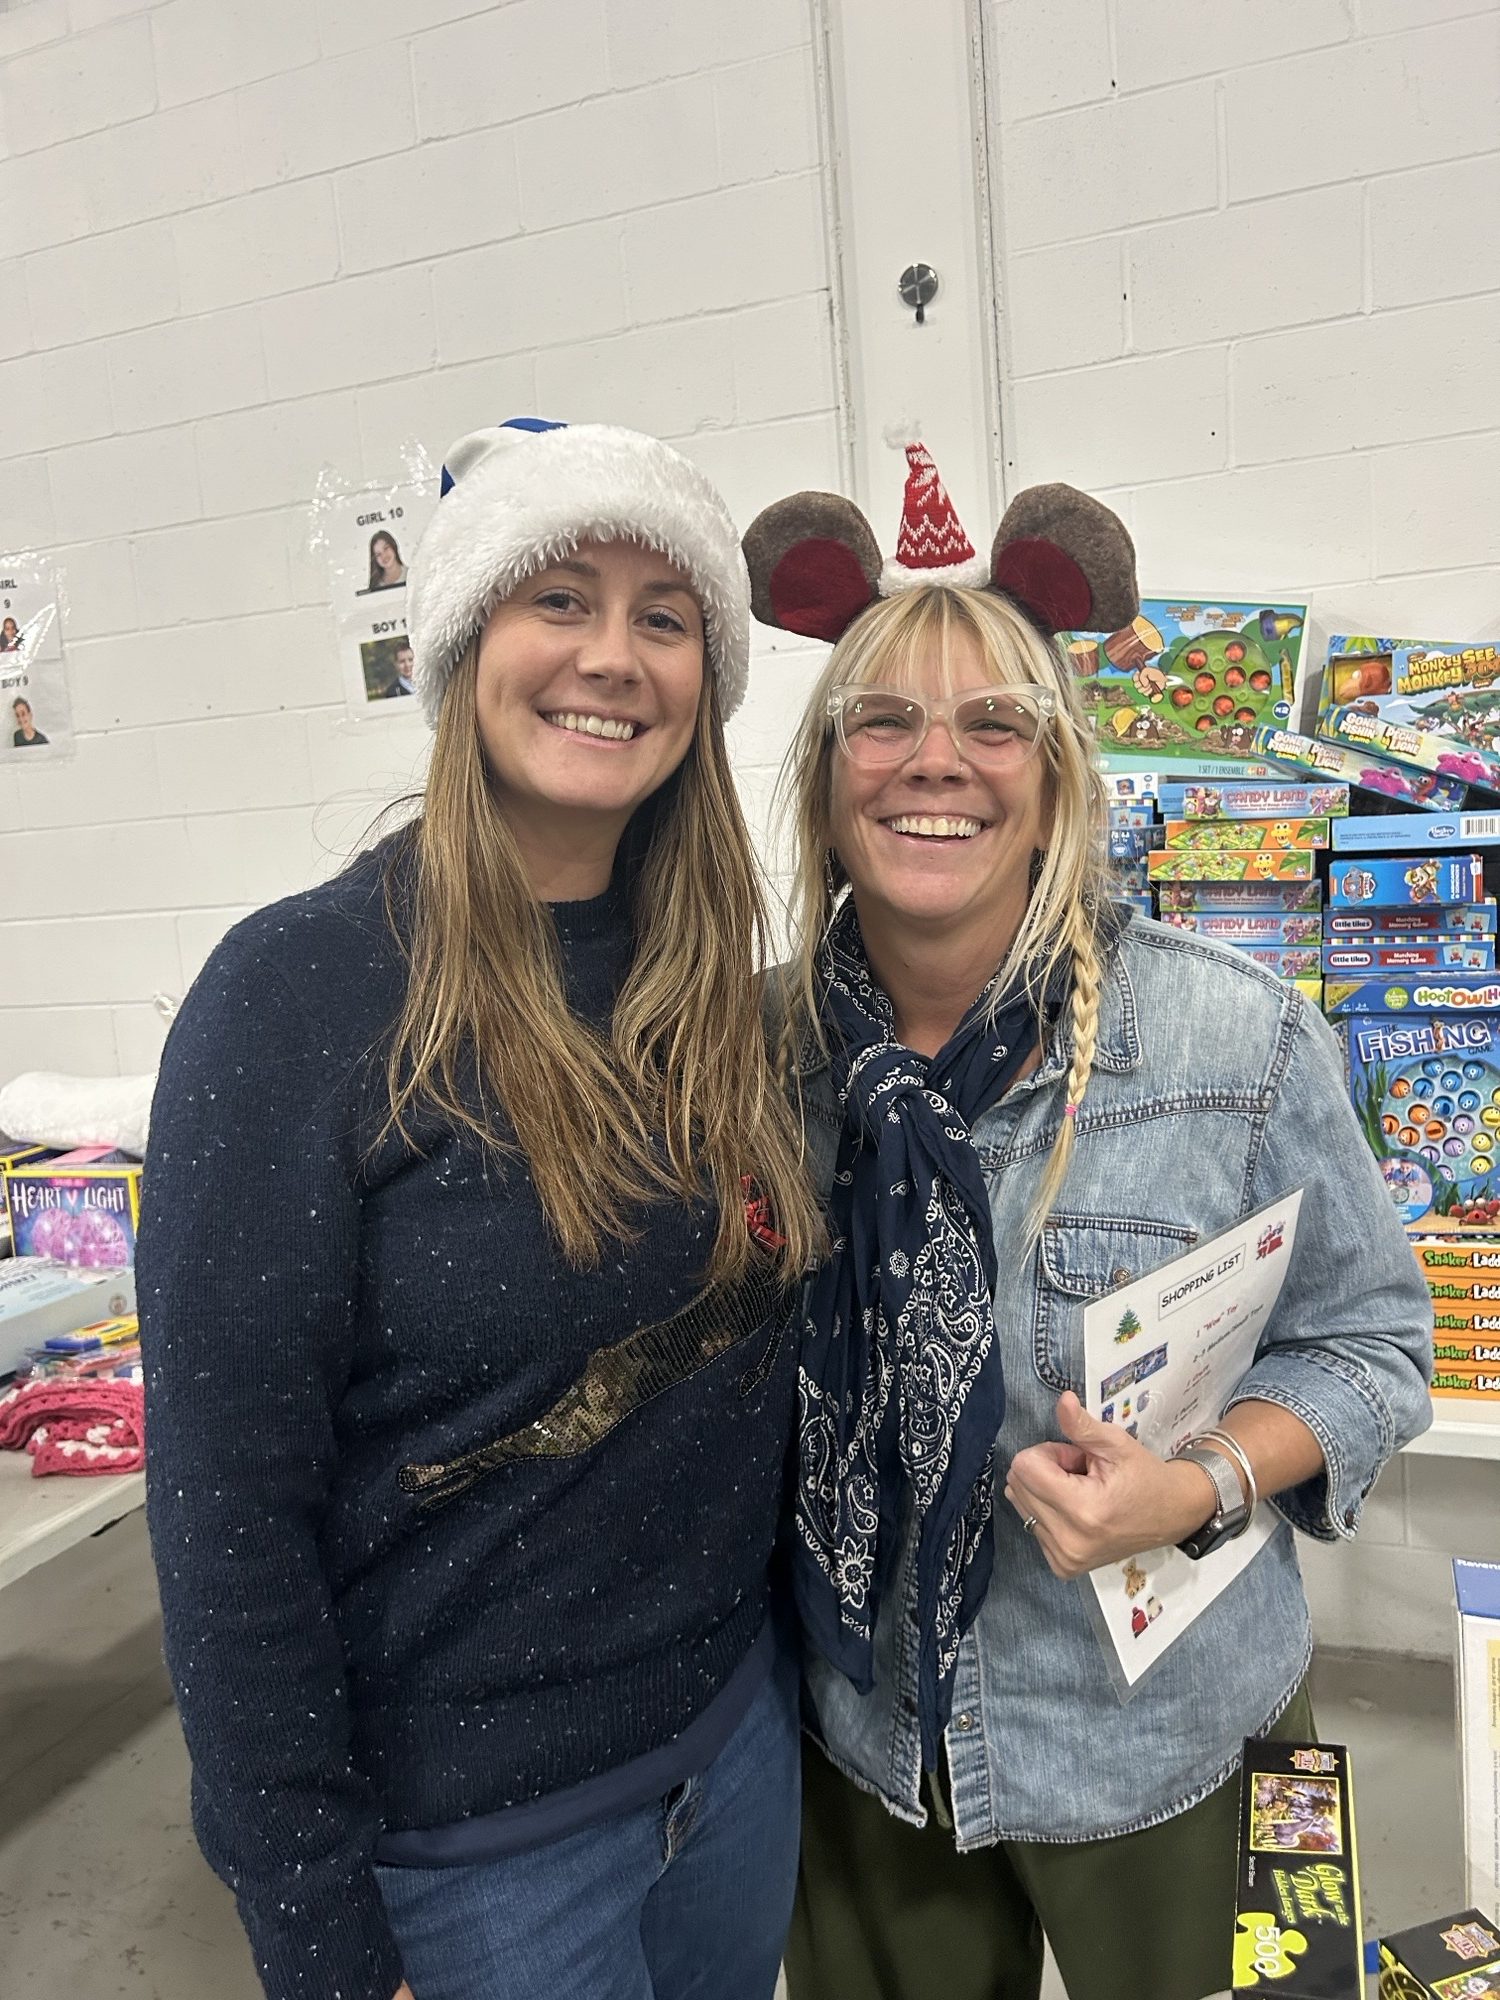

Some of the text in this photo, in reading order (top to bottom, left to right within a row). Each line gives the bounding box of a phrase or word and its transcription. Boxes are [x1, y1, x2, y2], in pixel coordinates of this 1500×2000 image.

[356, 507, 404, 526] GIRL 10
[0, 579, 17, 589] IRL
[372, 620, 397, 634] BOY
[1408, 654, 1462, 676] MONKEY
[1462, 646, 1495, 663] SEE
[2, 677, 22, 689] BOY
[1397, 666, 1462, 694] MONKEY
[1345, 712, 1378, 729] GONE
[1273, 730, 1304, 746] GONE
[1218, 766, 1245, 776] ENSEMBLE
[1226, 788, 1308, 803] CANDY LAND
[1202, 917, 1281, 930] CANDY LAND
[1334, 919, 1370, 928] little tikes
[1248, 951, 1281, 962] AND
[1350, 955, 1368, 963] tikes
[1383, 1024, 1399, 1035] THE
[1467, 1045, 1494, 1056] GAME
[12, 1182, 125, 1218] HEART LIGHT
[1472, 1252, 1500, 1268] Ladd
[1161, 1252, 1241, 1308] SHOPPING LIST
[1473, 1284, 1500, 1300] Ladd
[1434, 1314, 1468, 1330] nakes
[1473, 1314, 1500, 1331] Ladd
[1474, 1345, 1500, 1361] Ladd
[1477, 1375, 1500, 1391] Lad
[1305, 1863, 1346, 1905] Glow
[1272, 1868, 1297, 1924] Hidden Images
[1289, 1870, 1337, 1919] Dark
[1254, 1926, 1281, 1977] 500
